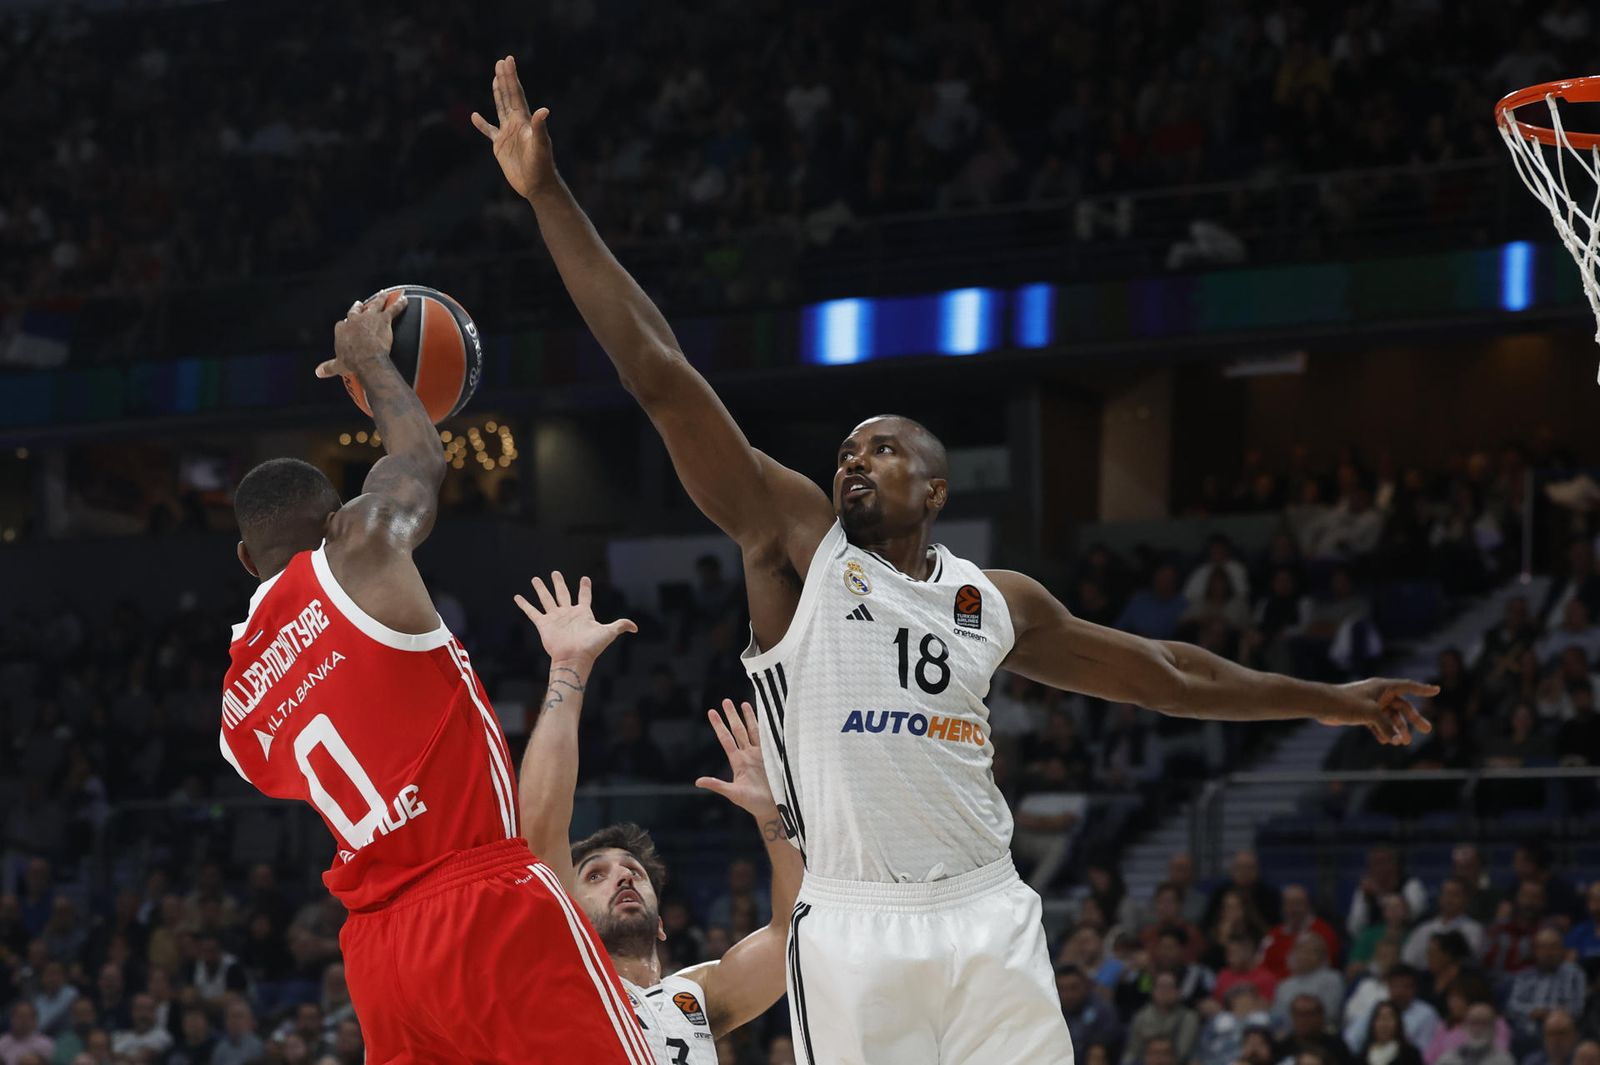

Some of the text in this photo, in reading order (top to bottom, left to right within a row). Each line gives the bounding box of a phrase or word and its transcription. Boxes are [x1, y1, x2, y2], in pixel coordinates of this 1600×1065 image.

[893, 627, 951, 695] 18
[953, 628, 987, 642] oneteam
[296, 651, 346, 703] BANKA
[841, 710, 985, 747] AUTOHERO
[293, 713, 388, 850] 0
